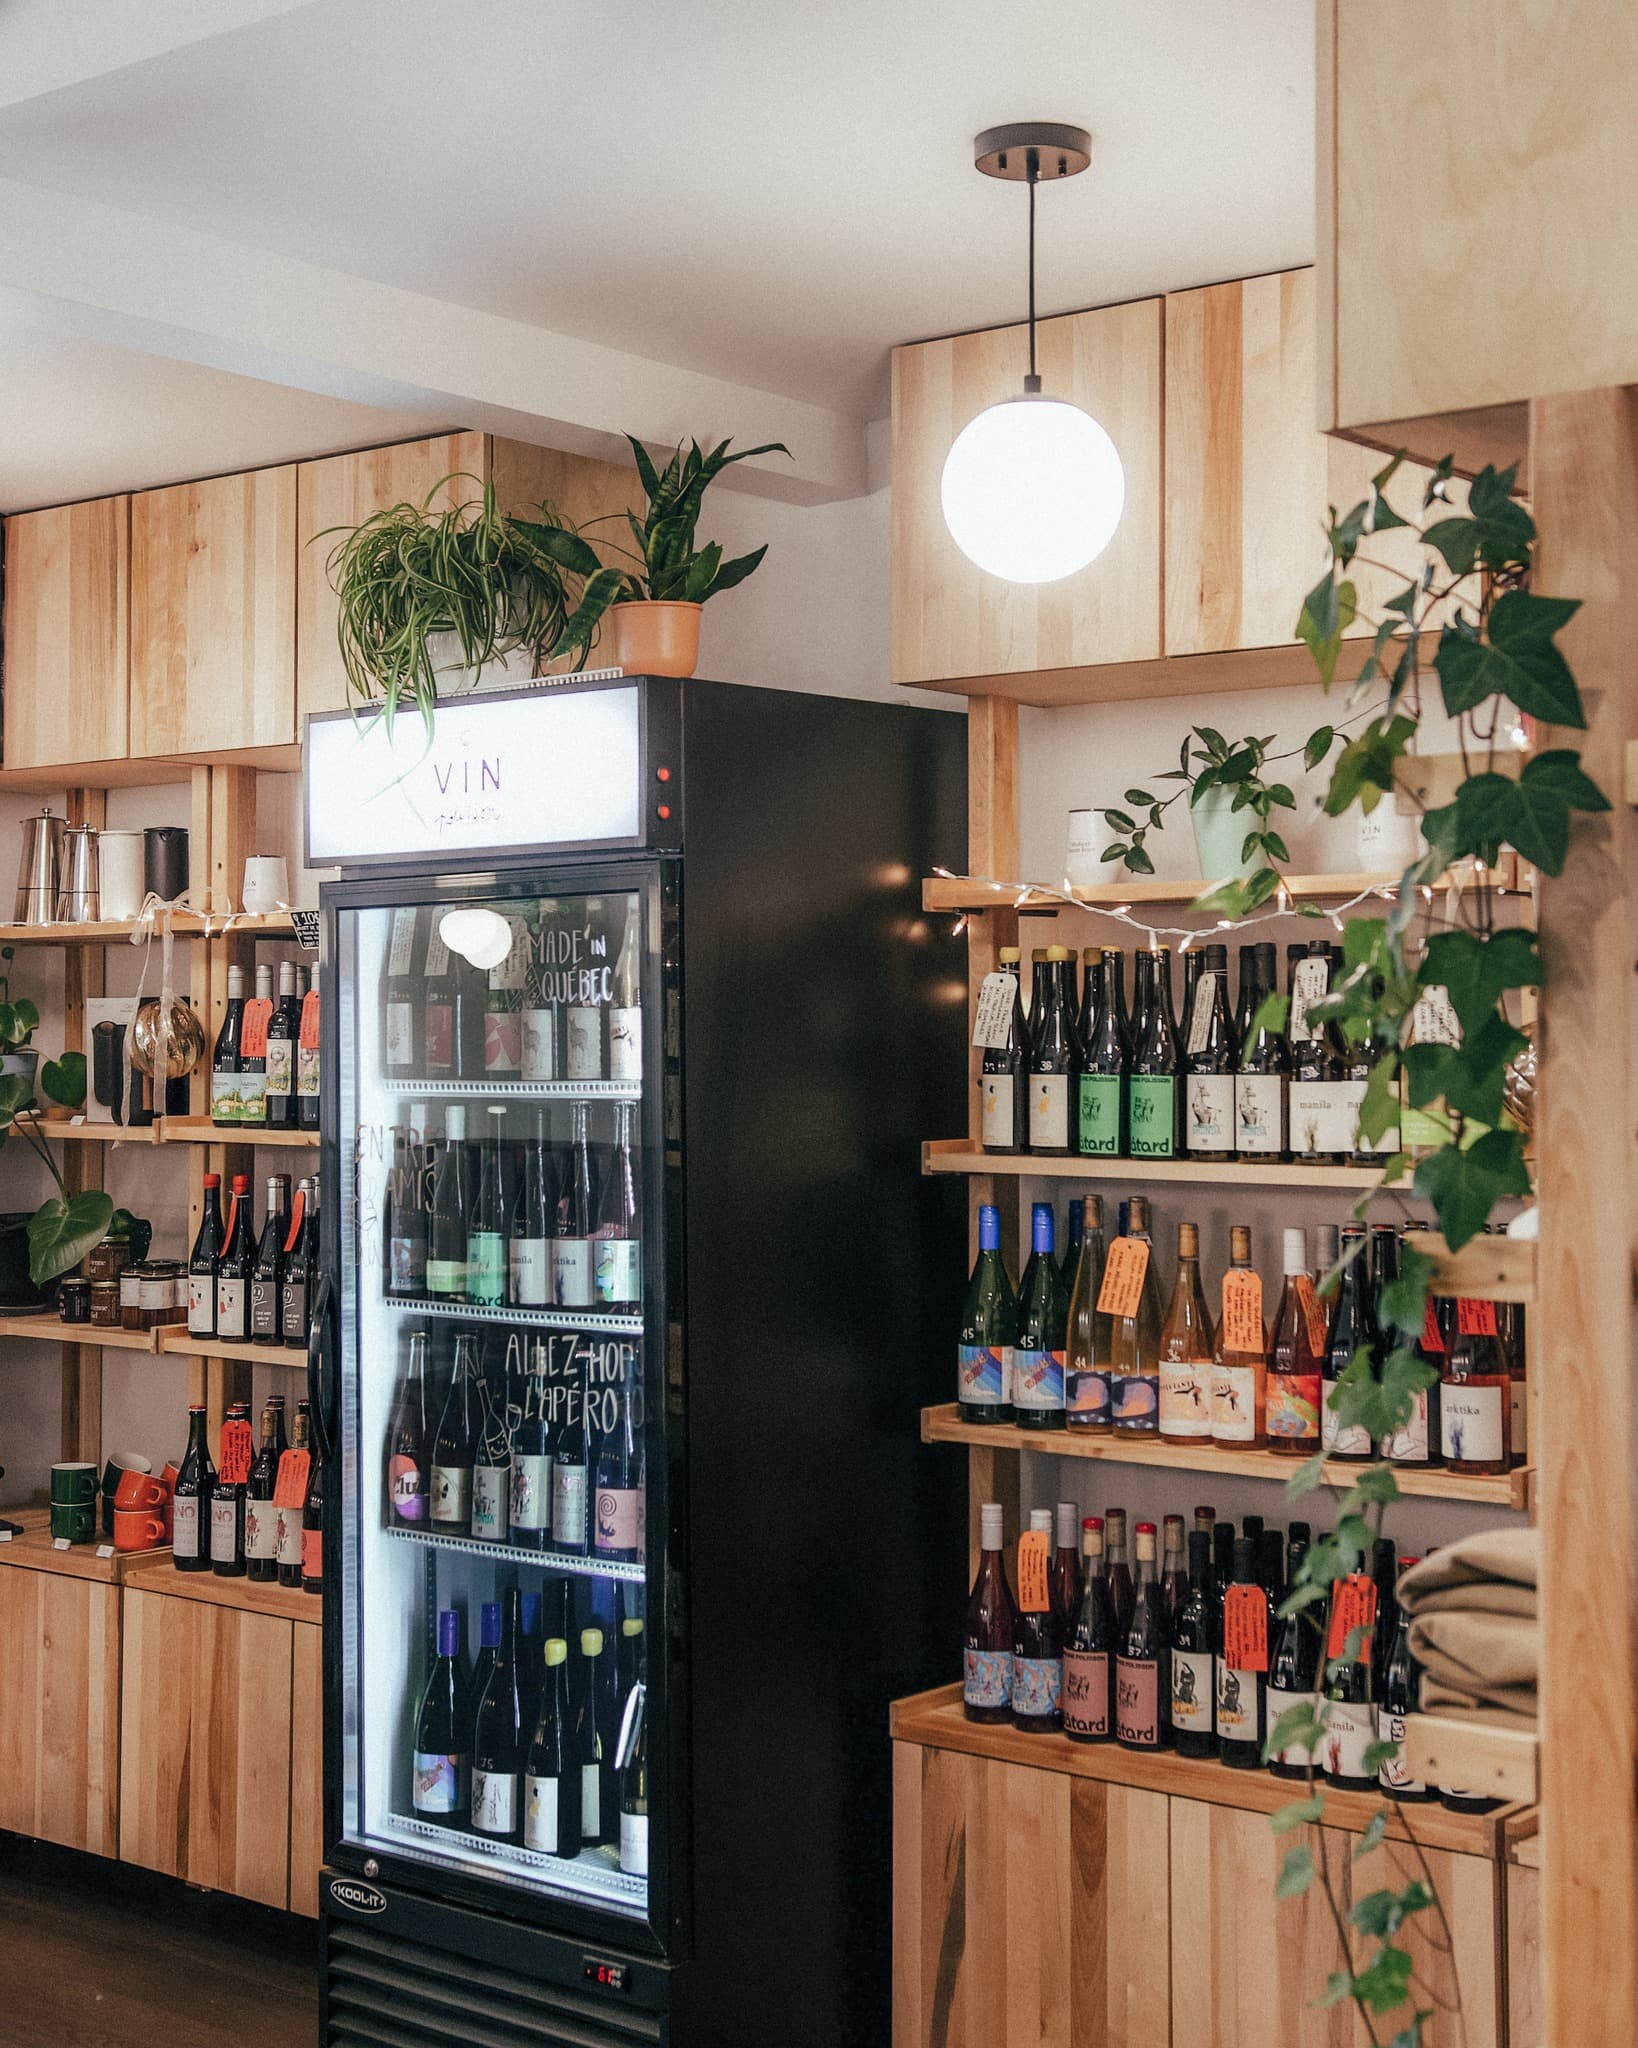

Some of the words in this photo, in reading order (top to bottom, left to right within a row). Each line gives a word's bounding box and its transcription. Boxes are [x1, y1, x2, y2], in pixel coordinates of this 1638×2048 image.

[434, 757, 500, 794] VIN
[528, 929, 584, 964] MADE
[590, 934, 607, 958] IN
[541, 965, 614, 1004] QUÉBEC
[1088, 1062, 1099, 1073] 39
[1299, 1099, 1332, 1110] manila
[962, 1327, 975, 1341] 45
[1020, 1335, 1035, 1348] 45
[505, 1333, 579, 1377] ALLEZ
[589, 1341, 634, 1383] HOP
[1167, 1348, 1181, 1363] 36
[1074, 1356, 1087, 1369] 44
[1453, 1371, 1468, 1384] 37
[969, 1637, 979, 1649] 39
[1178, 1634, 1191, 1647] 39
[479, 1757, 494, 1770] 75
